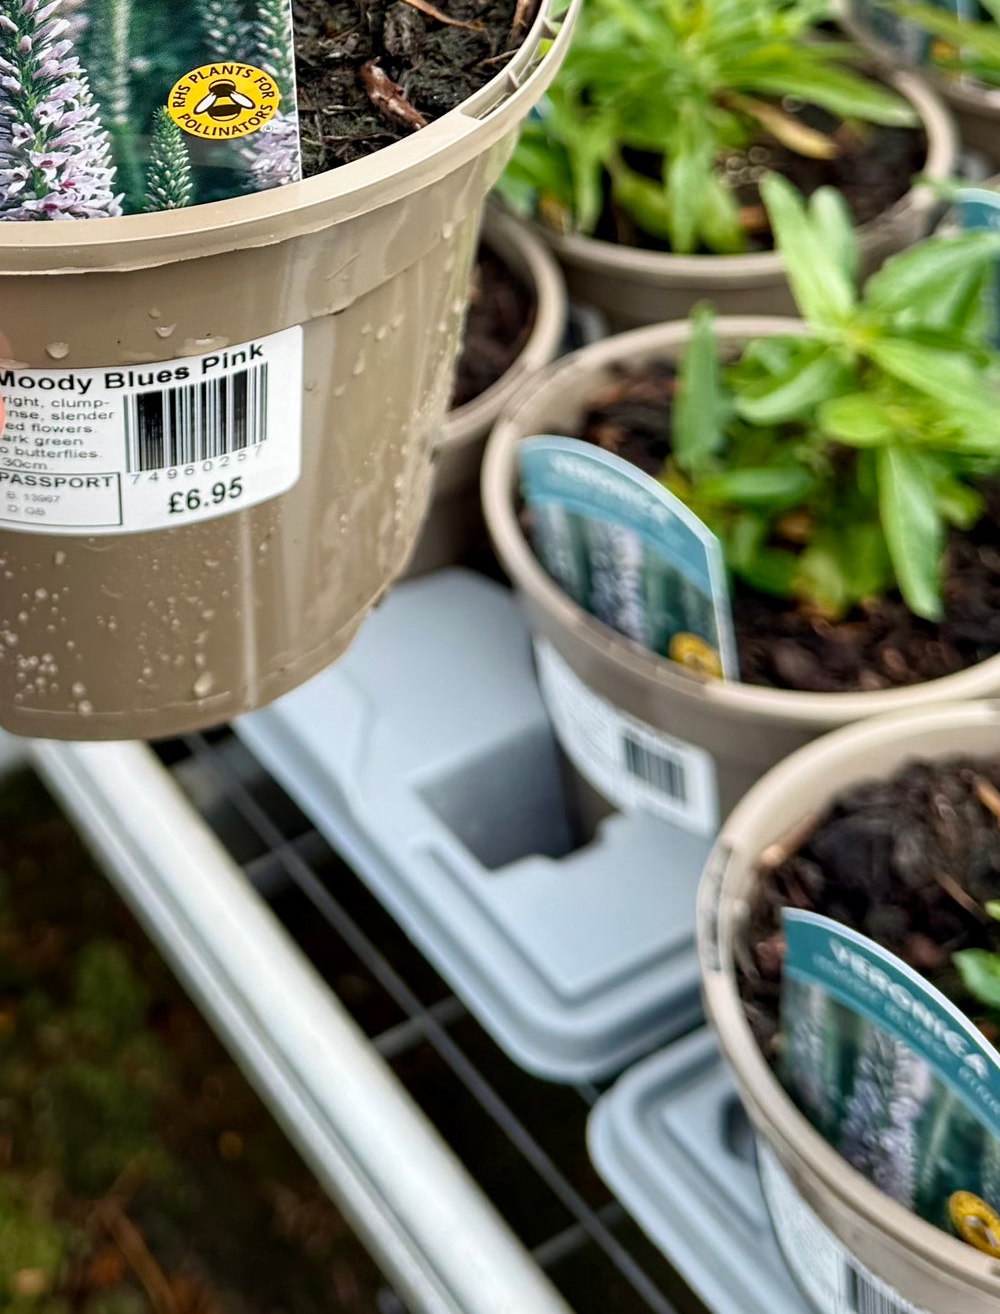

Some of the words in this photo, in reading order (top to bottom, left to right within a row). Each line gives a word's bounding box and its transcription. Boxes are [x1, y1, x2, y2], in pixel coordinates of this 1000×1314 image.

[172, 85, 191, 108] RHS
[188, 65, 254, 84] PLANTS
[253, 76, 275, 99] FOR
[178, 104, 273, 137] POLLINATORS
[104, 365, 190, 390] Blues
[201, 343, 264, 375] Pink
[2, 395, 45, 409] right,
[51, 398, 111, 410] clump-
[5, 421, 26, 431] ed
[6, 409, 45, 422] nse,
[51, 411, 116, 422] slender
[2, 434, 29, 444] ark
[35, 437, 84, 447] green
[168, 475, 244, 514] £6.95
